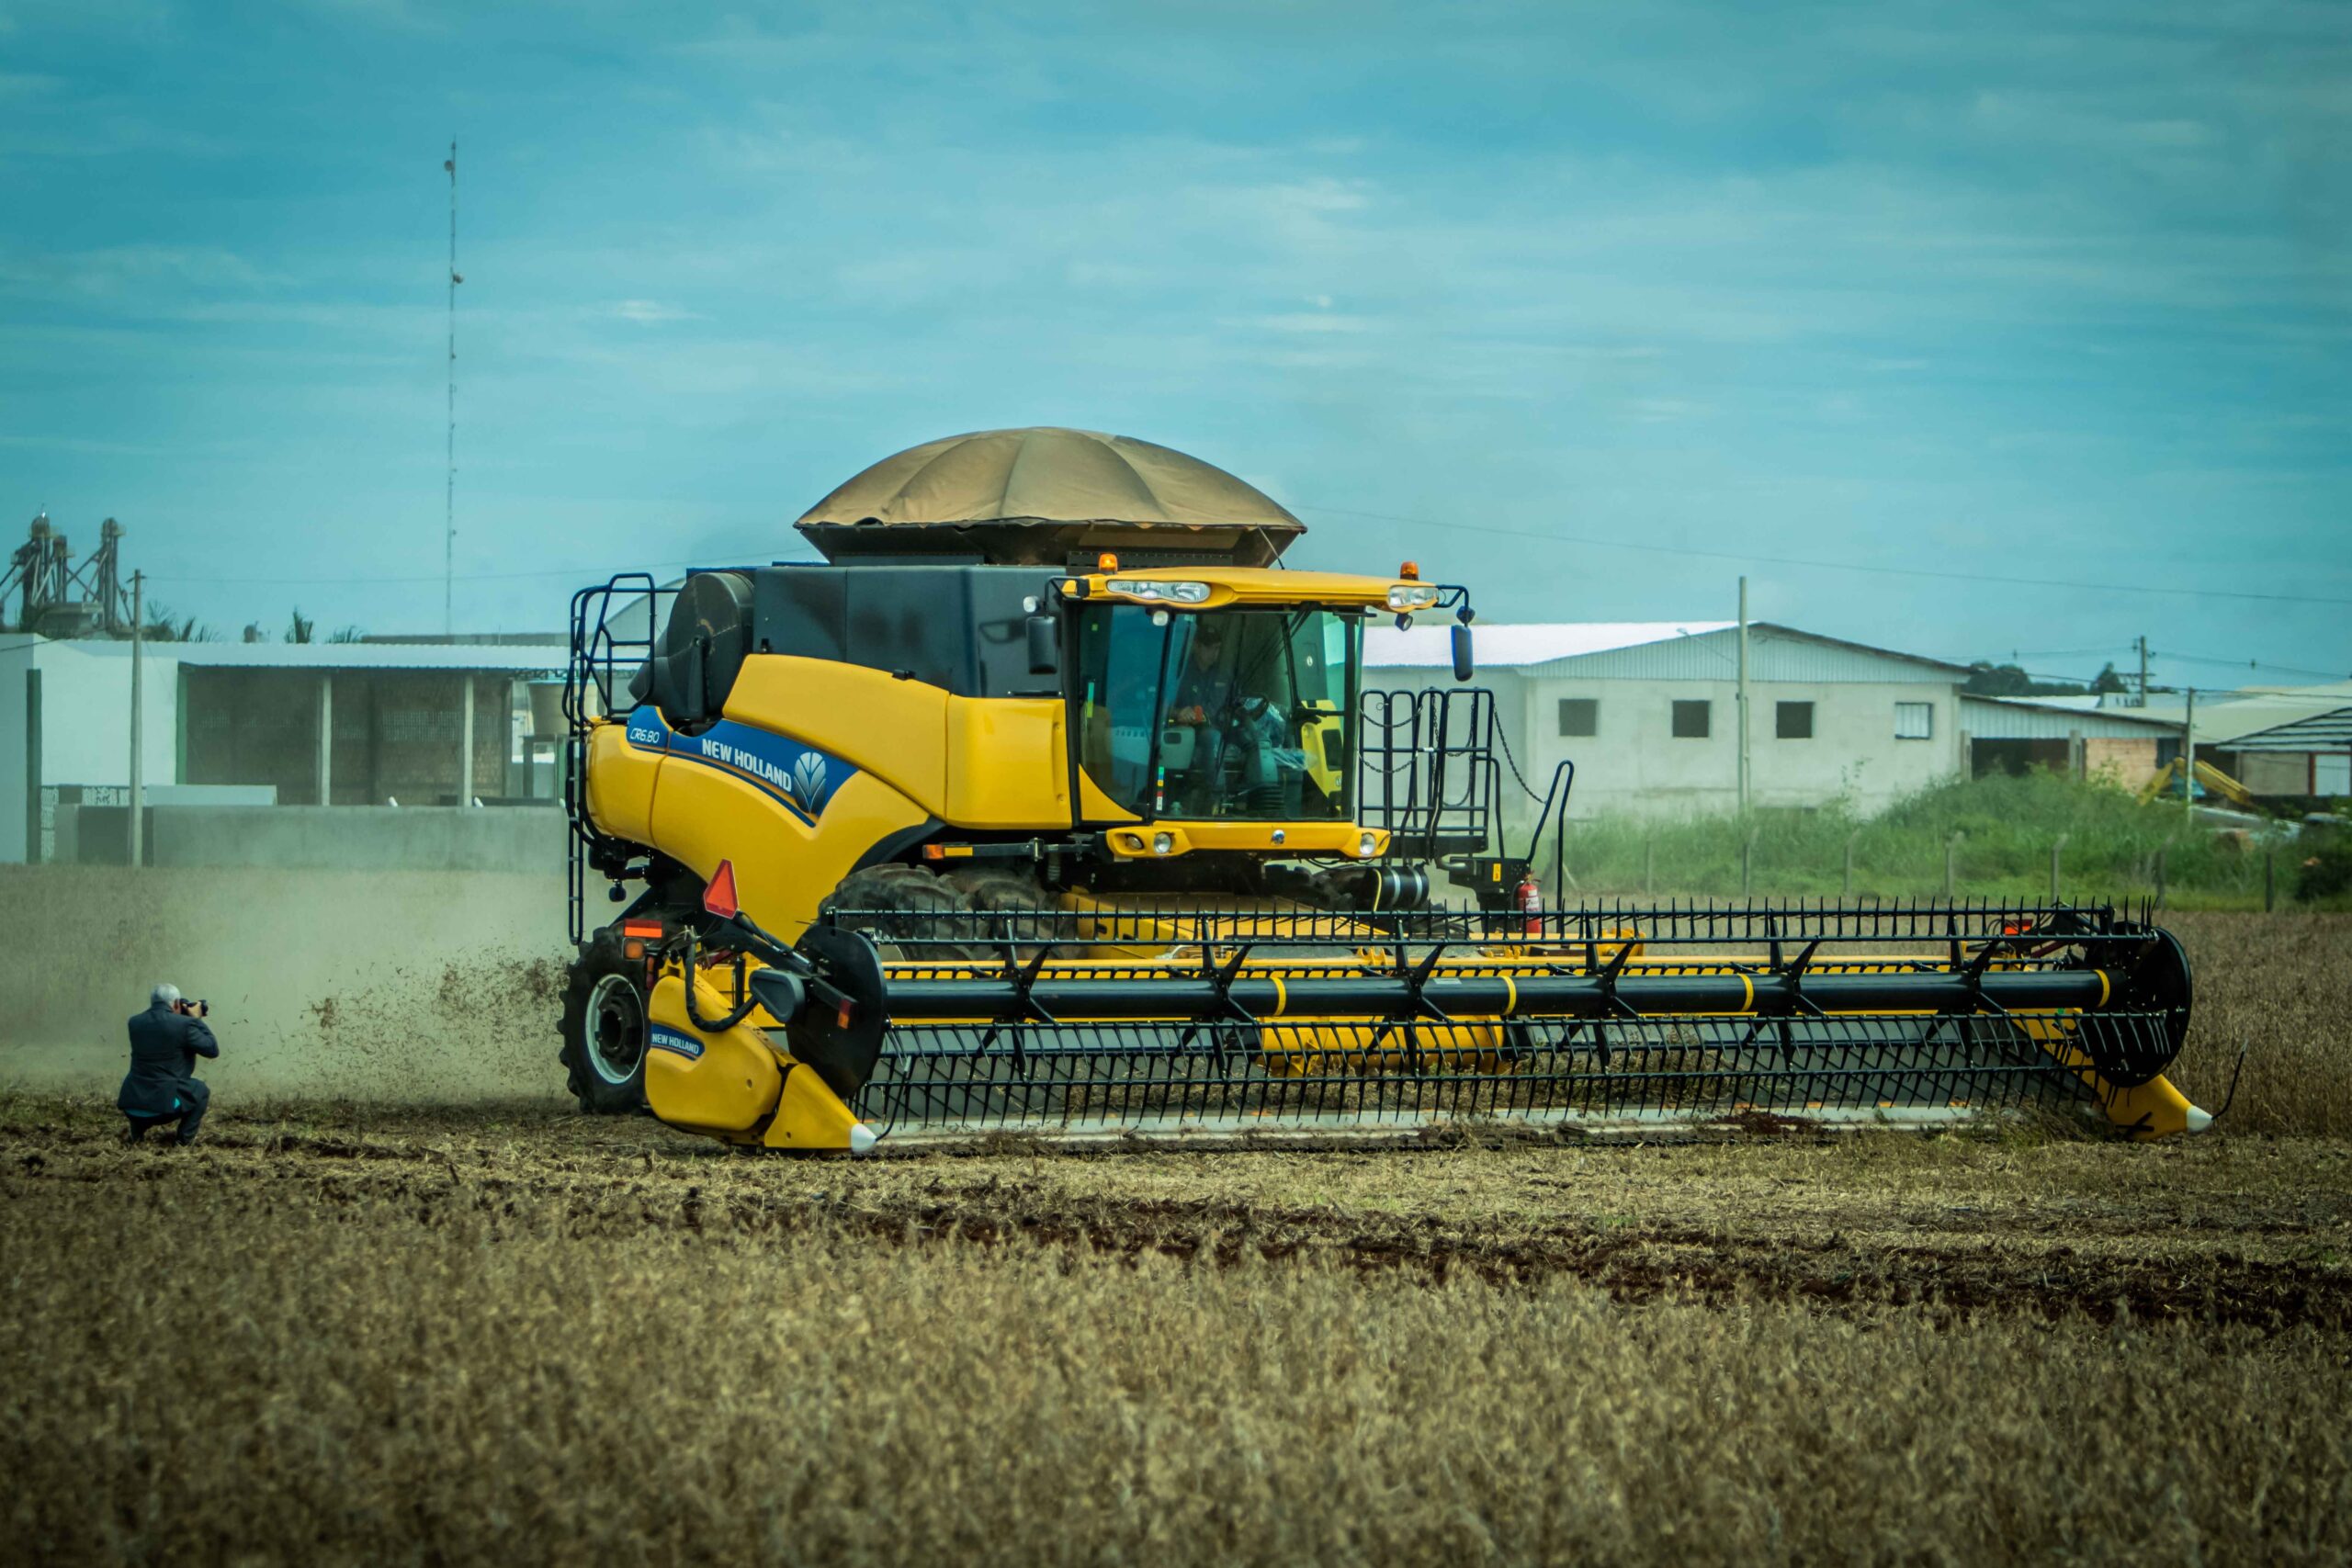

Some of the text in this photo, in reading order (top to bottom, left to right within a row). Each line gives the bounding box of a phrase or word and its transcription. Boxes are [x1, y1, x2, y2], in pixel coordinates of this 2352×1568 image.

[630, 728, 660, 743] CR6.80
[702, 739, 792, 792] NEW HOLLAND
[651, 1033, 700, 1055] NEW HOLLAND
